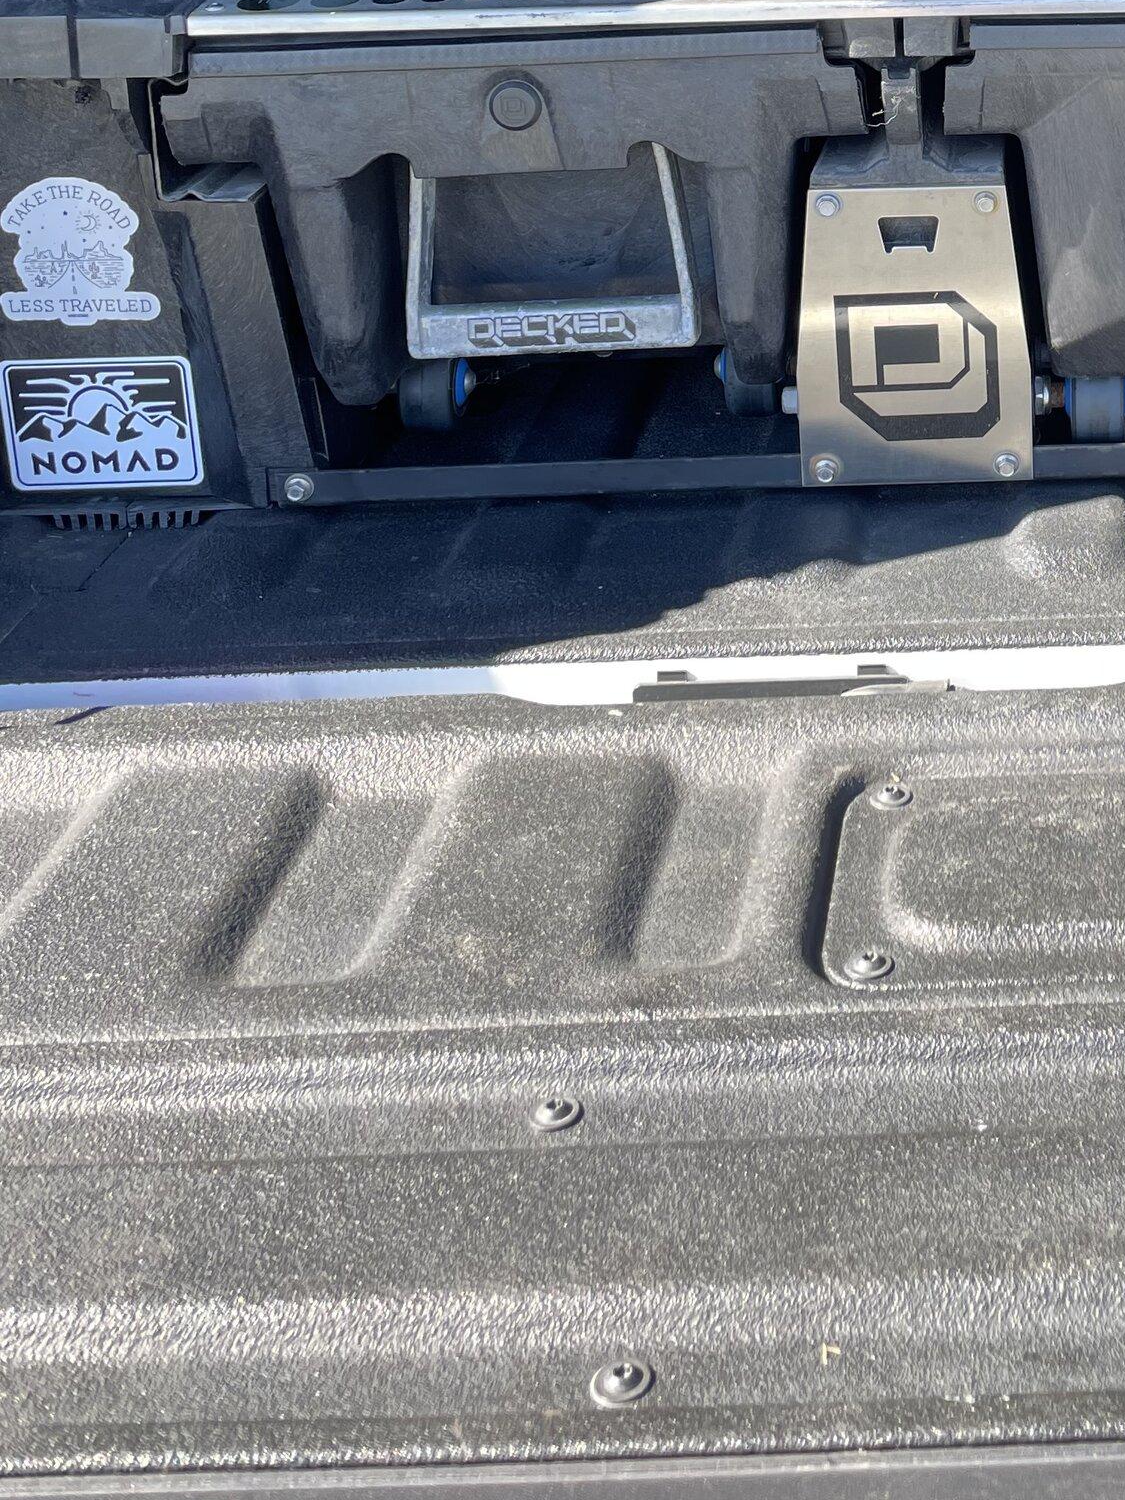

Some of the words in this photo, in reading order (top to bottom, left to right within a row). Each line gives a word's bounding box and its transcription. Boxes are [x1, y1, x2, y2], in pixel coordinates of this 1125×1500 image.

[8, 190, 47, 228] TAKE
[46, 185, 84, 200] THE
[87, 189, 132, 230] ROAD
[8, 299, 55, 313] LESS
[58, 298, 153, 313] TRAVELED
[466, 310, 637, 348] DECKED
[31, 448, 180, 477] NOMAD
